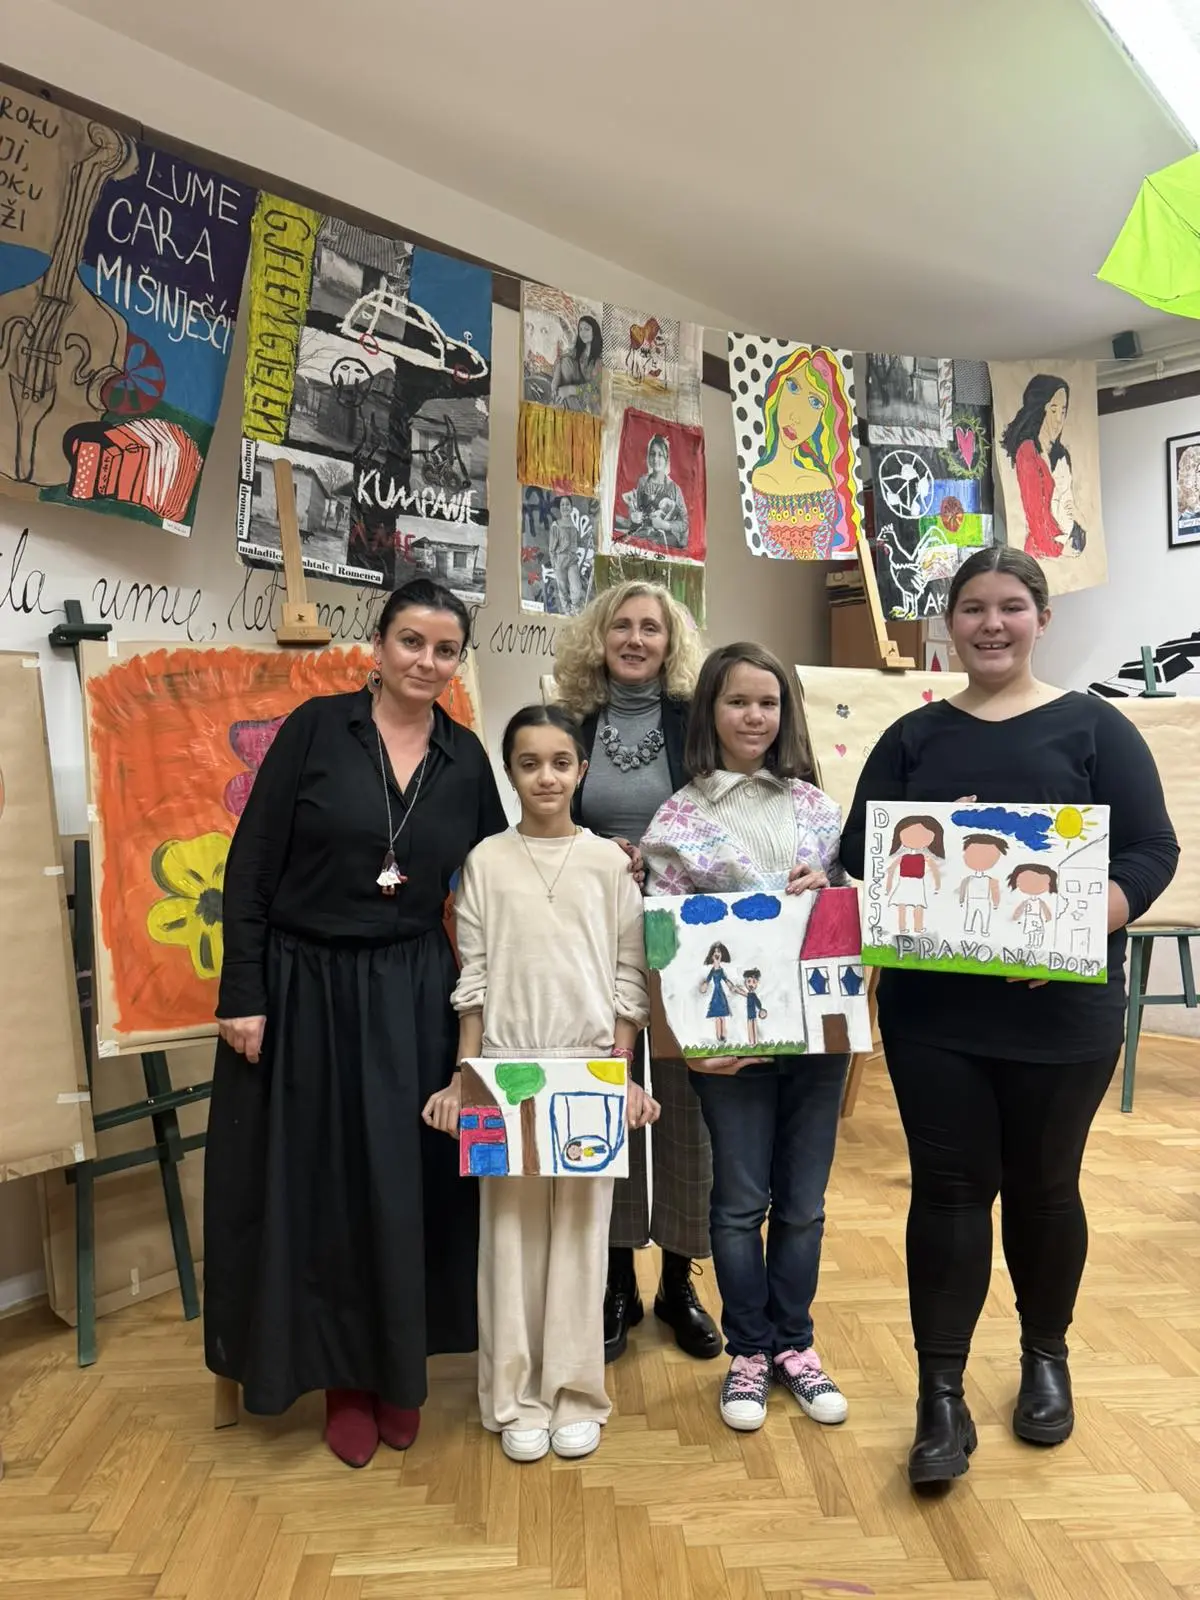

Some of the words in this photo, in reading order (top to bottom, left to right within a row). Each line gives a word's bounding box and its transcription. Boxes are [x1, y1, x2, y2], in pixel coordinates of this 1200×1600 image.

[146, 152, 240, 225] LUME
[239, 545, 283, 561] maladile
[302, 559, 330, 572] ahtale
[337, 566, 382, 582] Romenca
[895, 934, 994, 964] PRAVO
[1002, 946, 1038, 967] NA
[1048, 951, 1101, 978] DOM
